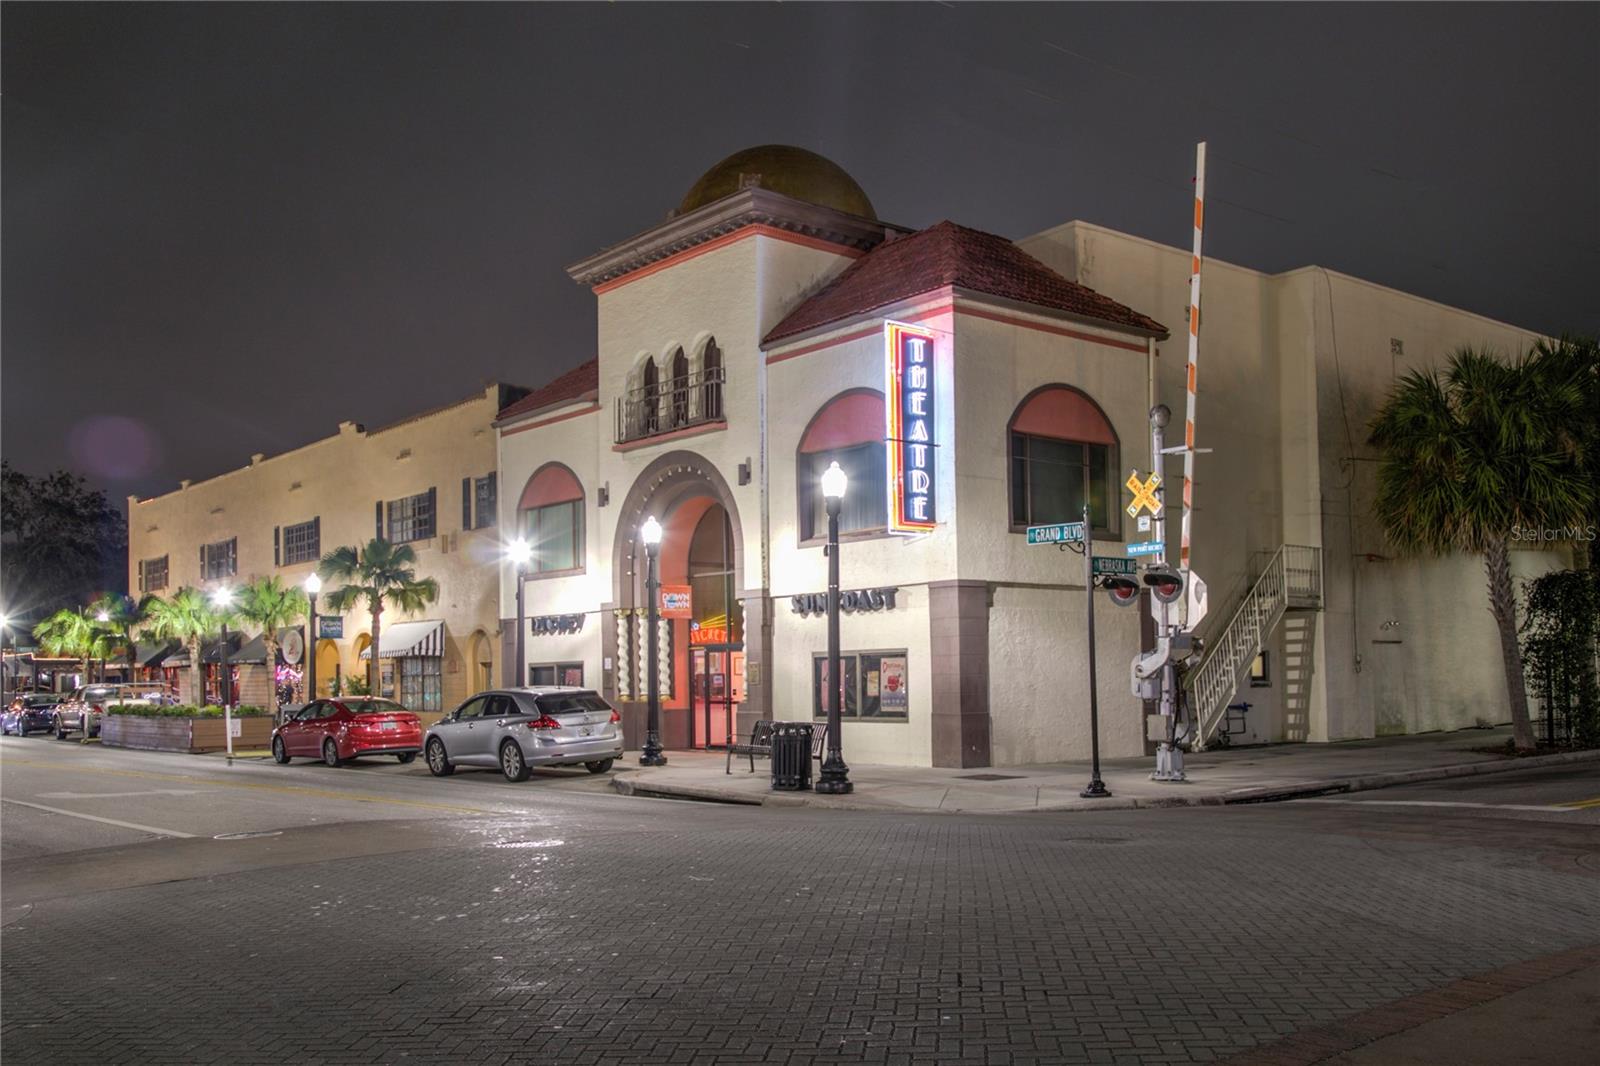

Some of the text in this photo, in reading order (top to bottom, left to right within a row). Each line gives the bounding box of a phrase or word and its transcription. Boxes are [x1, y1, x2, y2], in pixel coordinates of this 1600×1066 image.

[907, 338, 930, 520] THEATRE
[1035, 525, 1082, 542] GRAND BLVD
[1099, 559, 1137, 574] NEBRASKA AVE
[662, 593, 689, 601] DOWN
[664, 601, 689, 609] TOWN
[690, 628, 730, 644] TICKET
